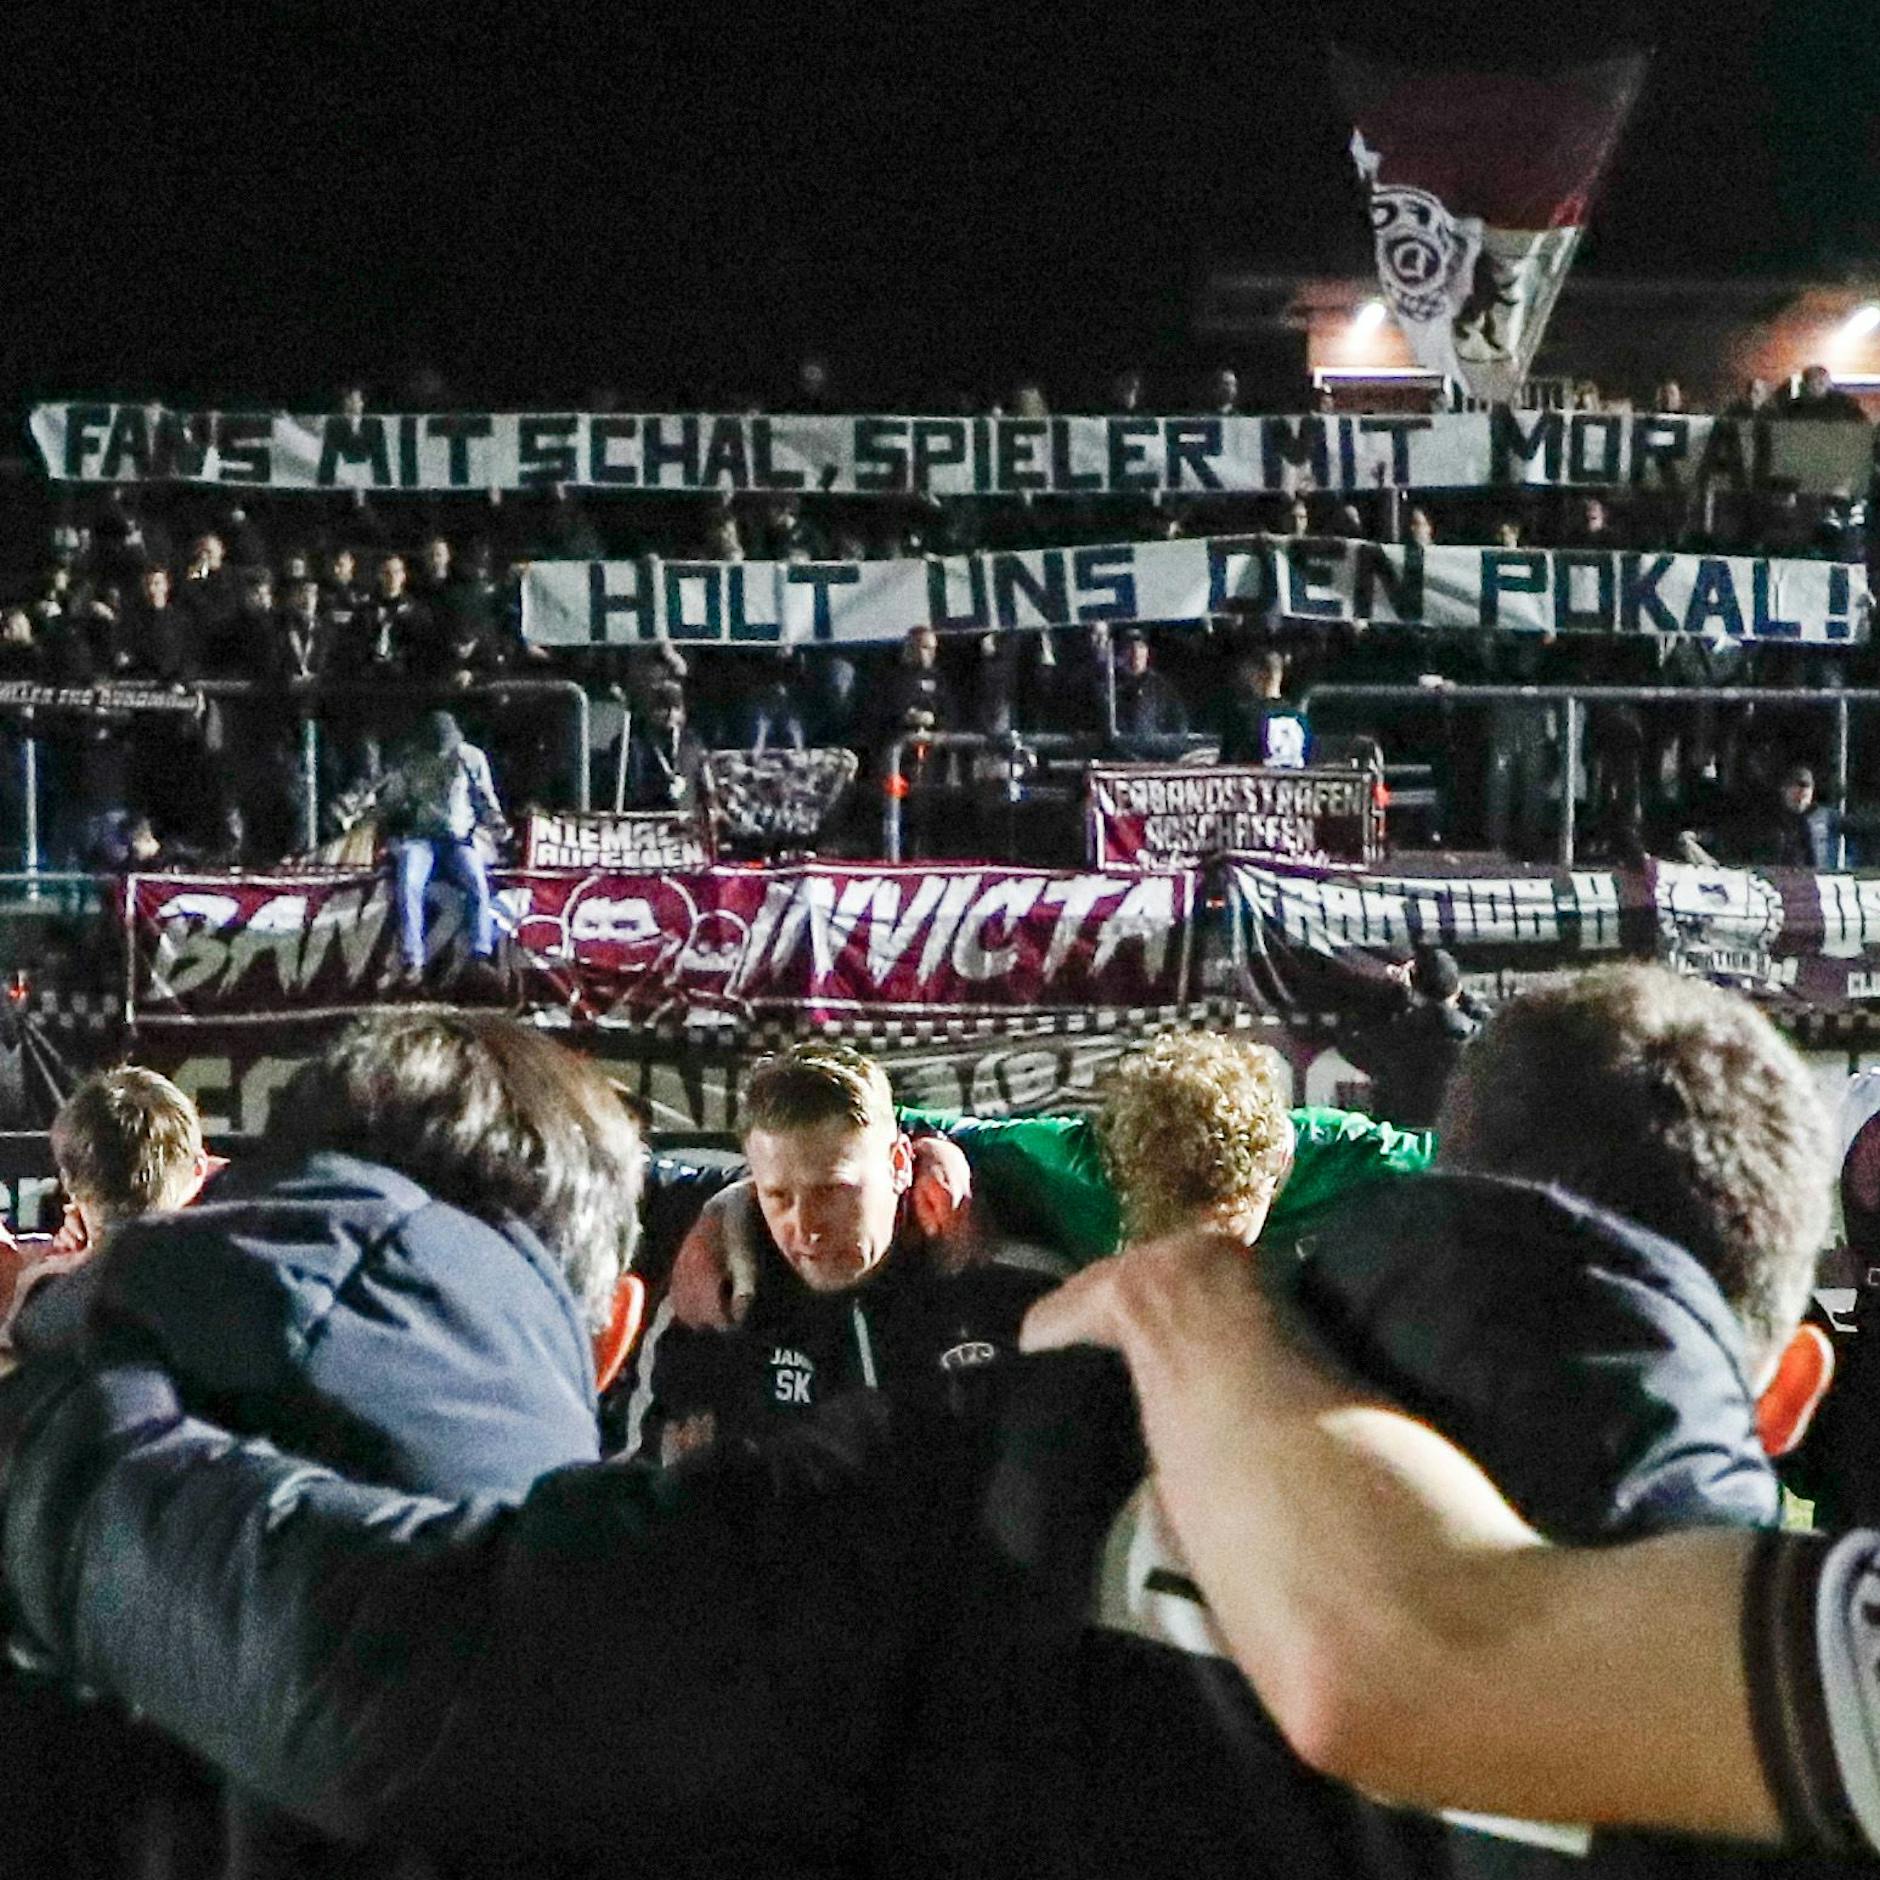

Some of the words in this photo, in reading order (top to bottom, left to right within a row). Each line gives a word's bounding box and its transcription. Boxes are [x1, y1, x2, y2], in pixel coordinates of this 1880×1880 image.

[65, 403, 273, 482] FANS
[318, 414, 492, 486] MIT
[855, 417, 1223, 490] SPIELER
[1261, 416, 1432, 488] MIT
[1490, 407, 1800, 490] MORAL
[589, 562, 860, 641] HOLT
[927, 545, 1137, 631] UNS
[1207, 537, 1424, 620] DEN
[1480, 550, 1850, 639] POKAL!
[537, 815, 692, 850] NIEMAL
[738, 875, 1176, 988] INVICTA
[775, 1369, 812, 1404] SK
